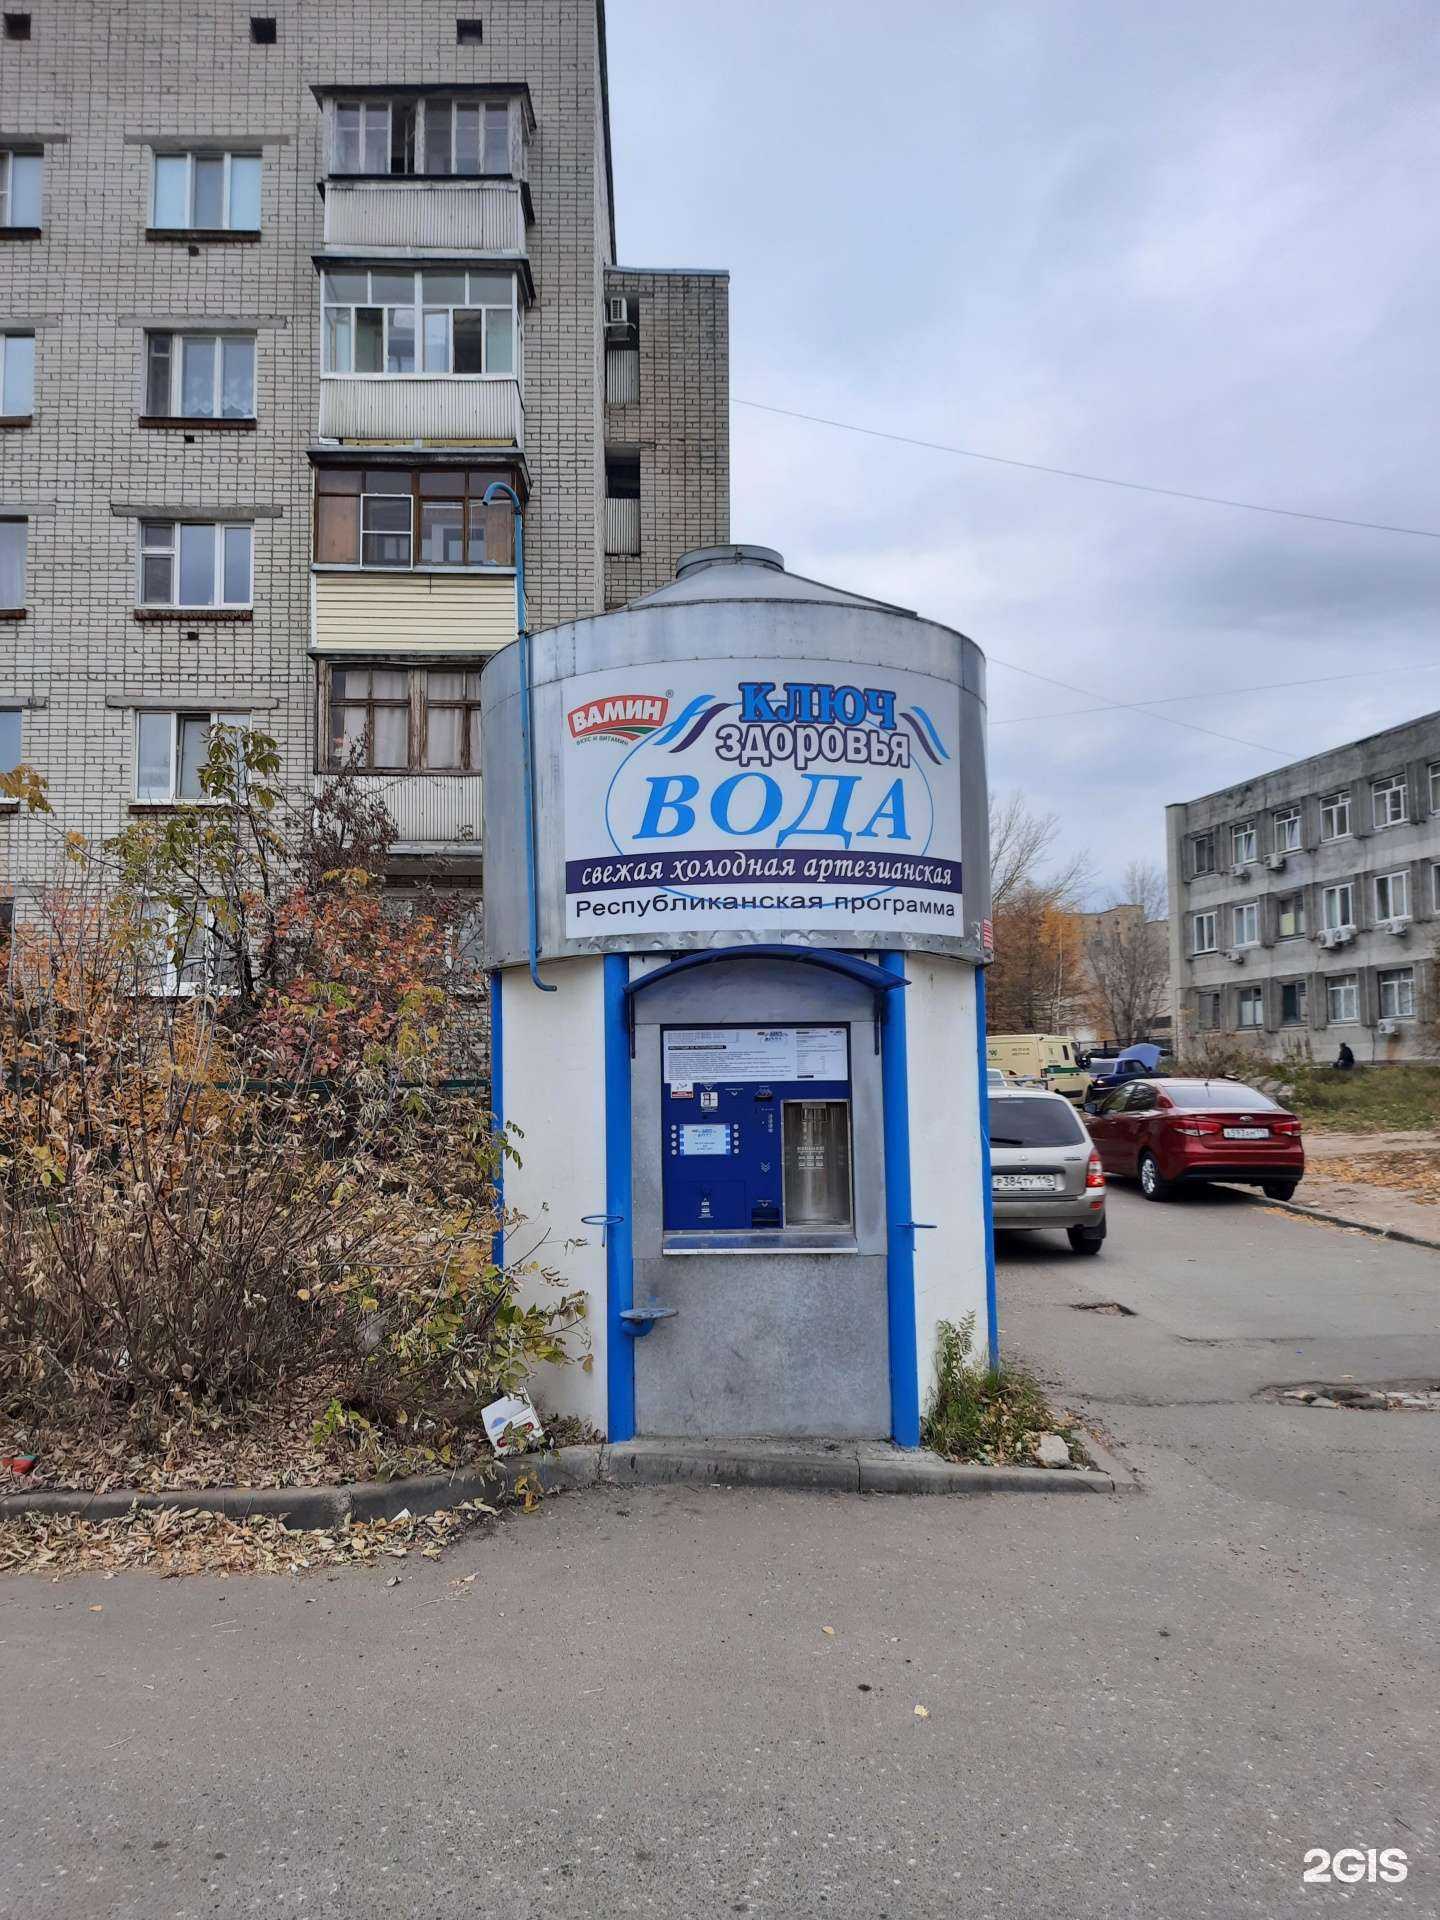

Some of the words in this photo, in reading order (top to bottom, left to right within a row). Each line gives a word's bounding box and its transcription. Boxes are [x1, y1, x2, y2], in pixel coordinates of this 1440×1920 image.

[572, 700, 662, 733] ВАМИН
[738, 682, 896, 730] КЛЮЧ
[632, 772, 911, 849] ВОДА
[582, 861, 664, 885] свежая
[670, 851, 796, 881] холодная
[803, 855, 952, 885] артезианская
[576, 894, 823, 917] Республиканская
[835, 897, 954, 916] программа
